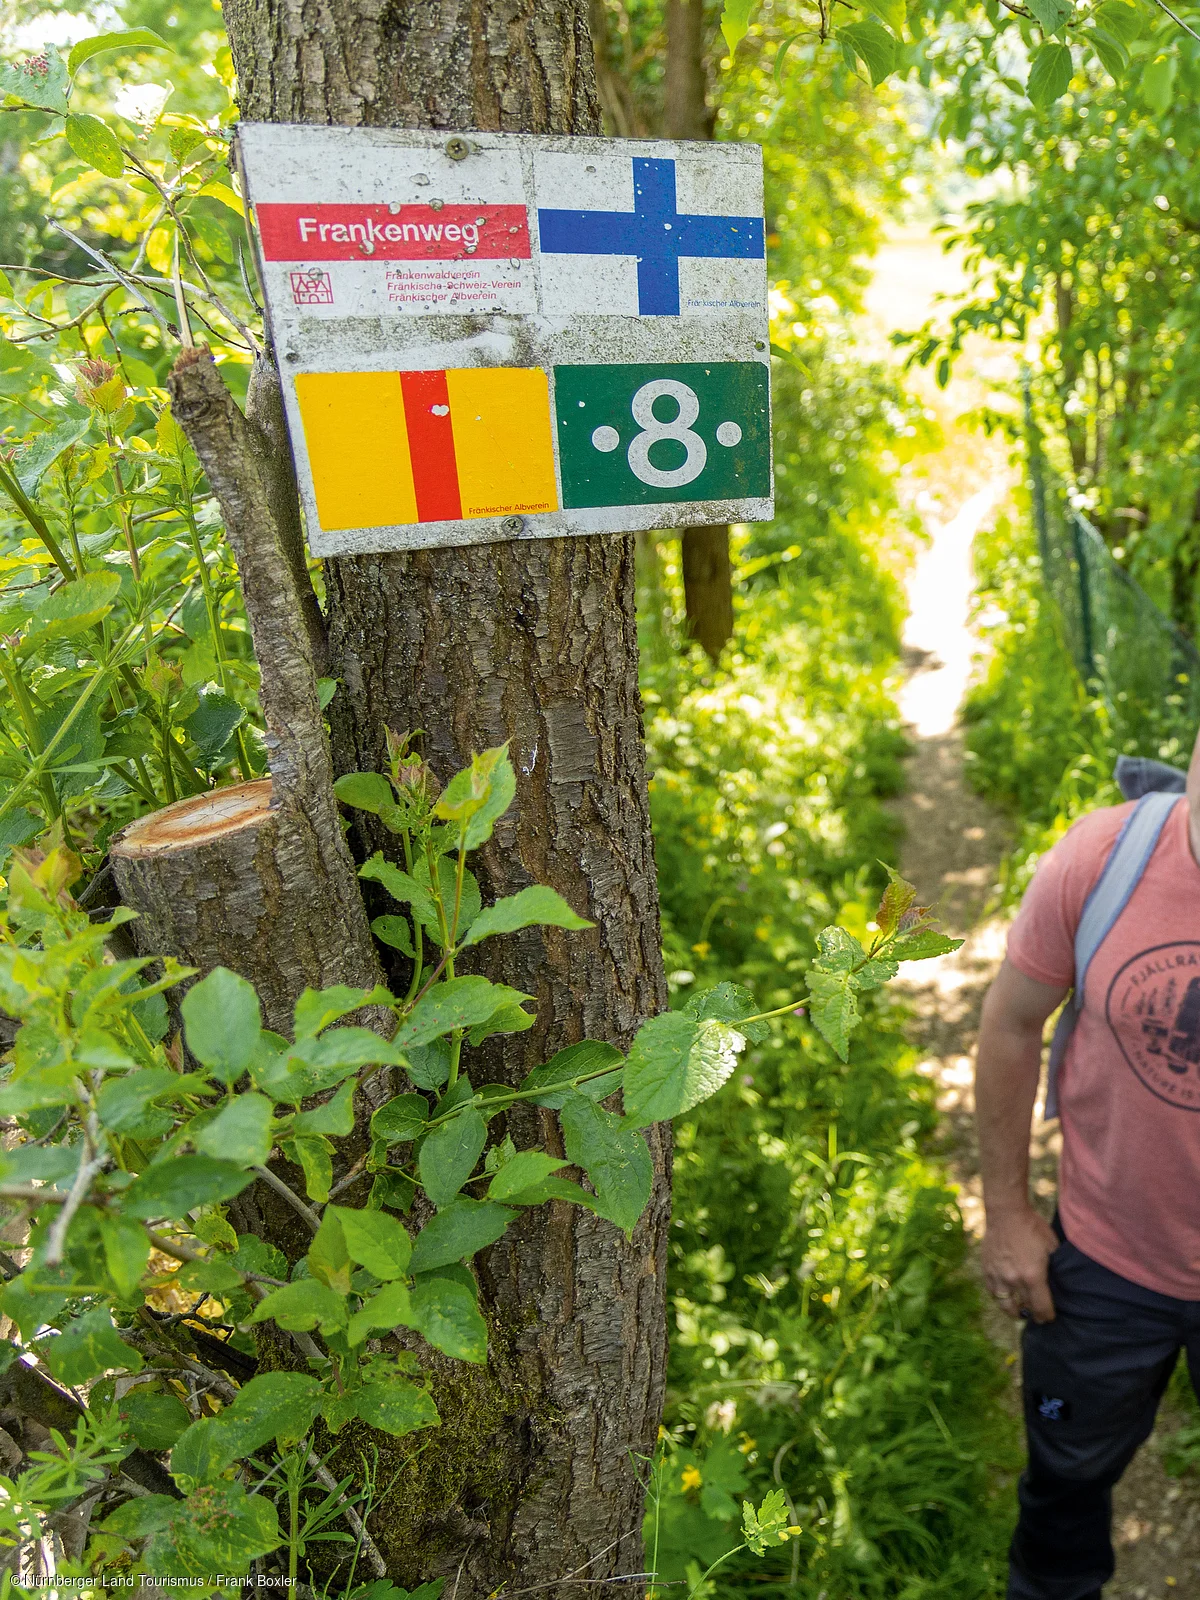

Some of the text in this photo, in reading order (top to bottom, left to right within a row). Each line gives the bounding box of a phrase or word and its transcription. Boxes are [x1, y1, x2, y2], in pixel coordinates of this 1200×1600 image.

[298, 217, 480, 247] Frankenweg
[385, 269, 480, 280] Frankenwaldverein
[387, 280, 521, 291] Fränkische-Schweiz-Verein
[388, 291, 497, 302] Fränkischer Albverein
[627, 378, 708, 489] 8
[468, 501, 550, 515] Fränkischer Albverein
